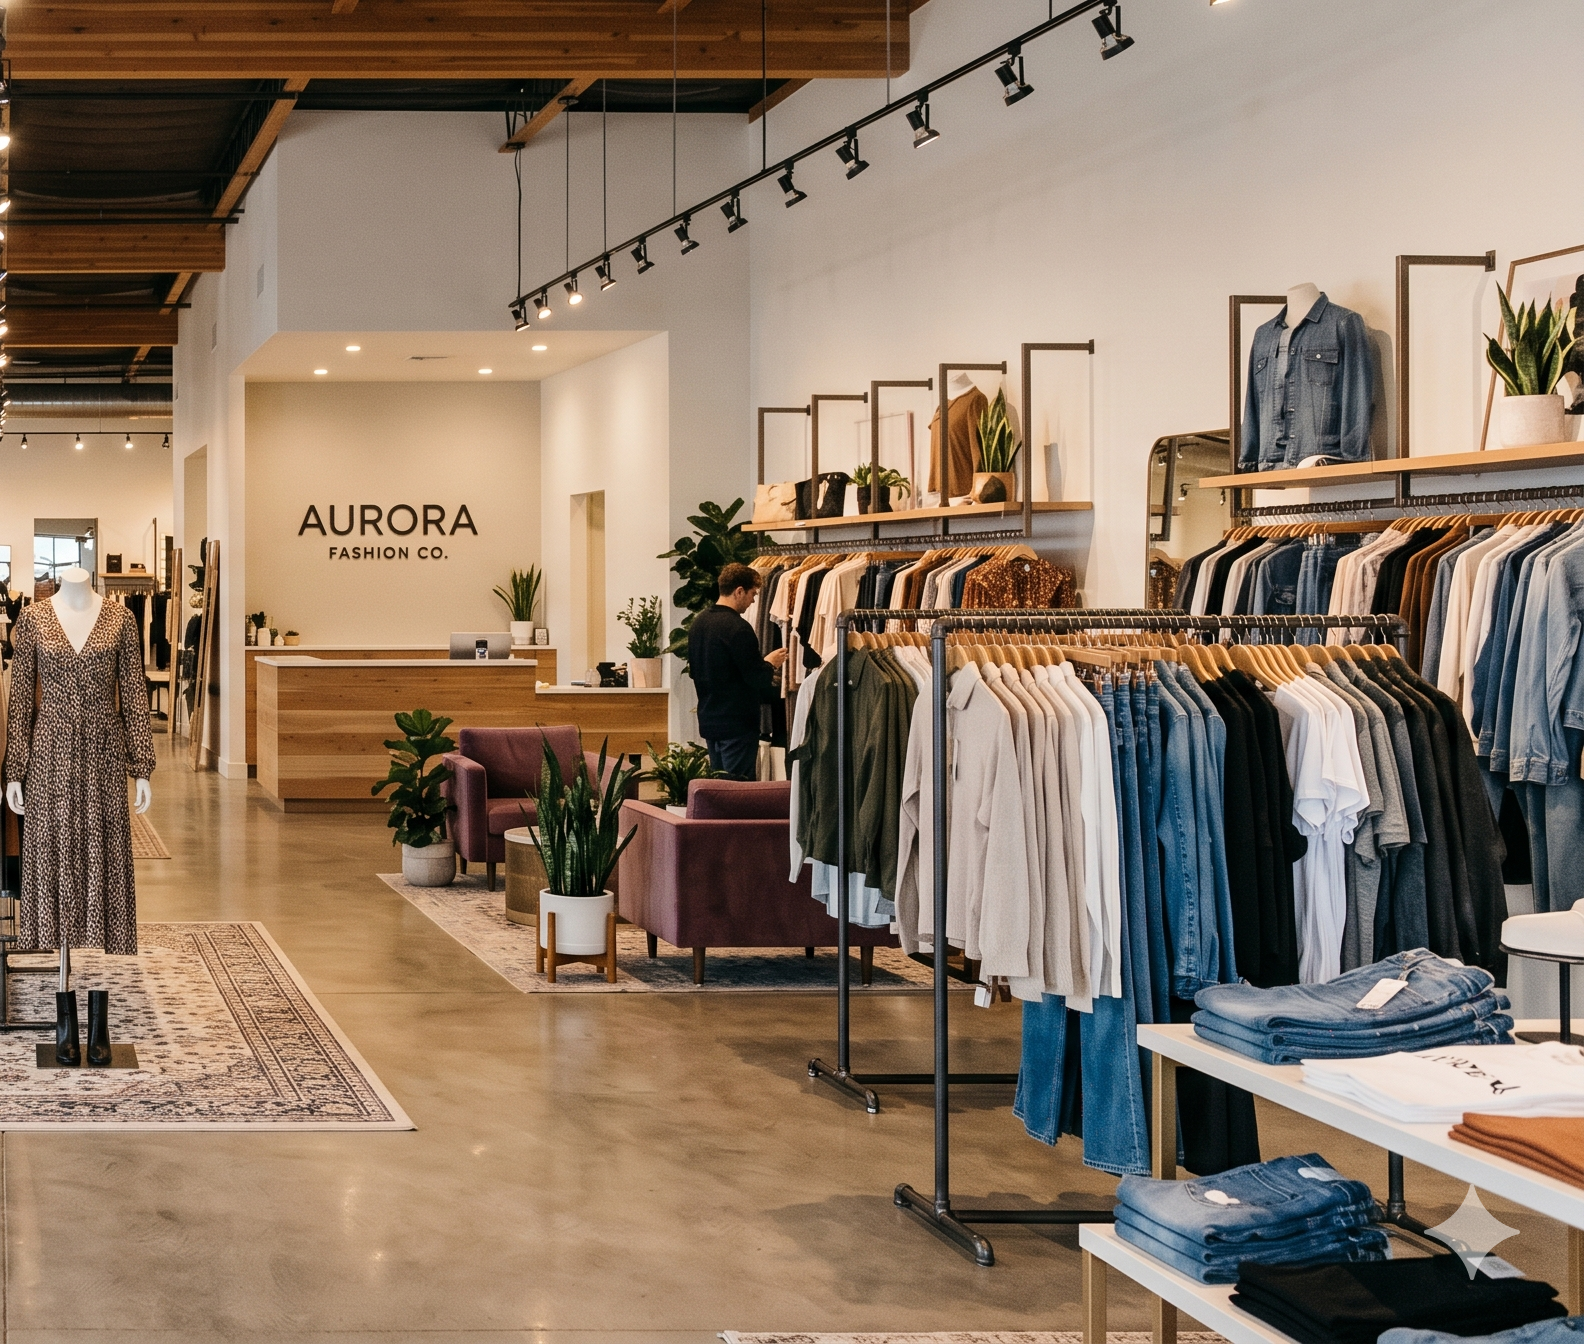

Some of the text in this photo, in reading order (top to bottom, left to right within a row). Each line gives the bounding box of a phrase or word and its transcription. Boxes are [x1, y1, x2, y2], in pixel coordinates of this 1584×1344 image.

[297, 503, 479, 536] AURORA
[329, 546, 449, 560] FASHION CO.
